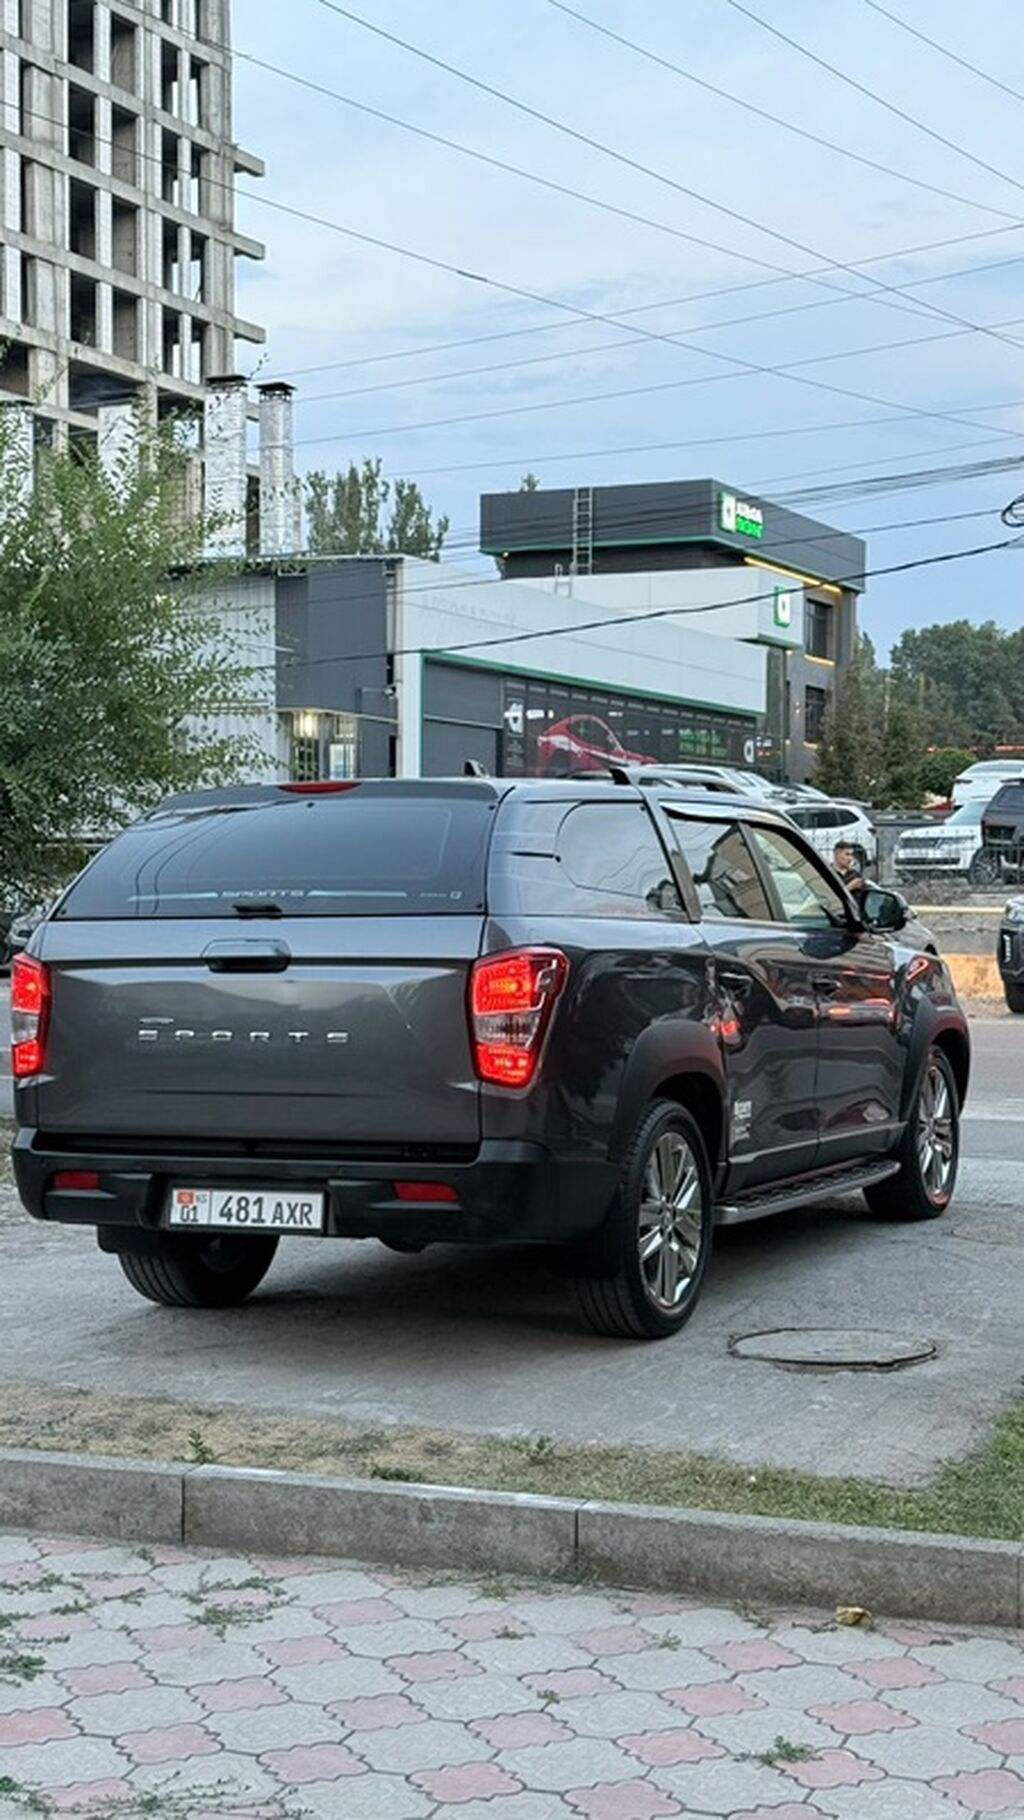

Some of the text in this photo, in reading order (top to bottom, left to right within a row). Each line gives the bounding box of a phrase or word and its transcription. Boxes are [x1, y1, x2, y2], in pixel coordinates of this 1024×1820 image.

[221, 888, 304, 898] SPORTS
[138, 1029, 349, 1044] SPORTS
[180, 1196, 313, 1226] 01 481 AXR
